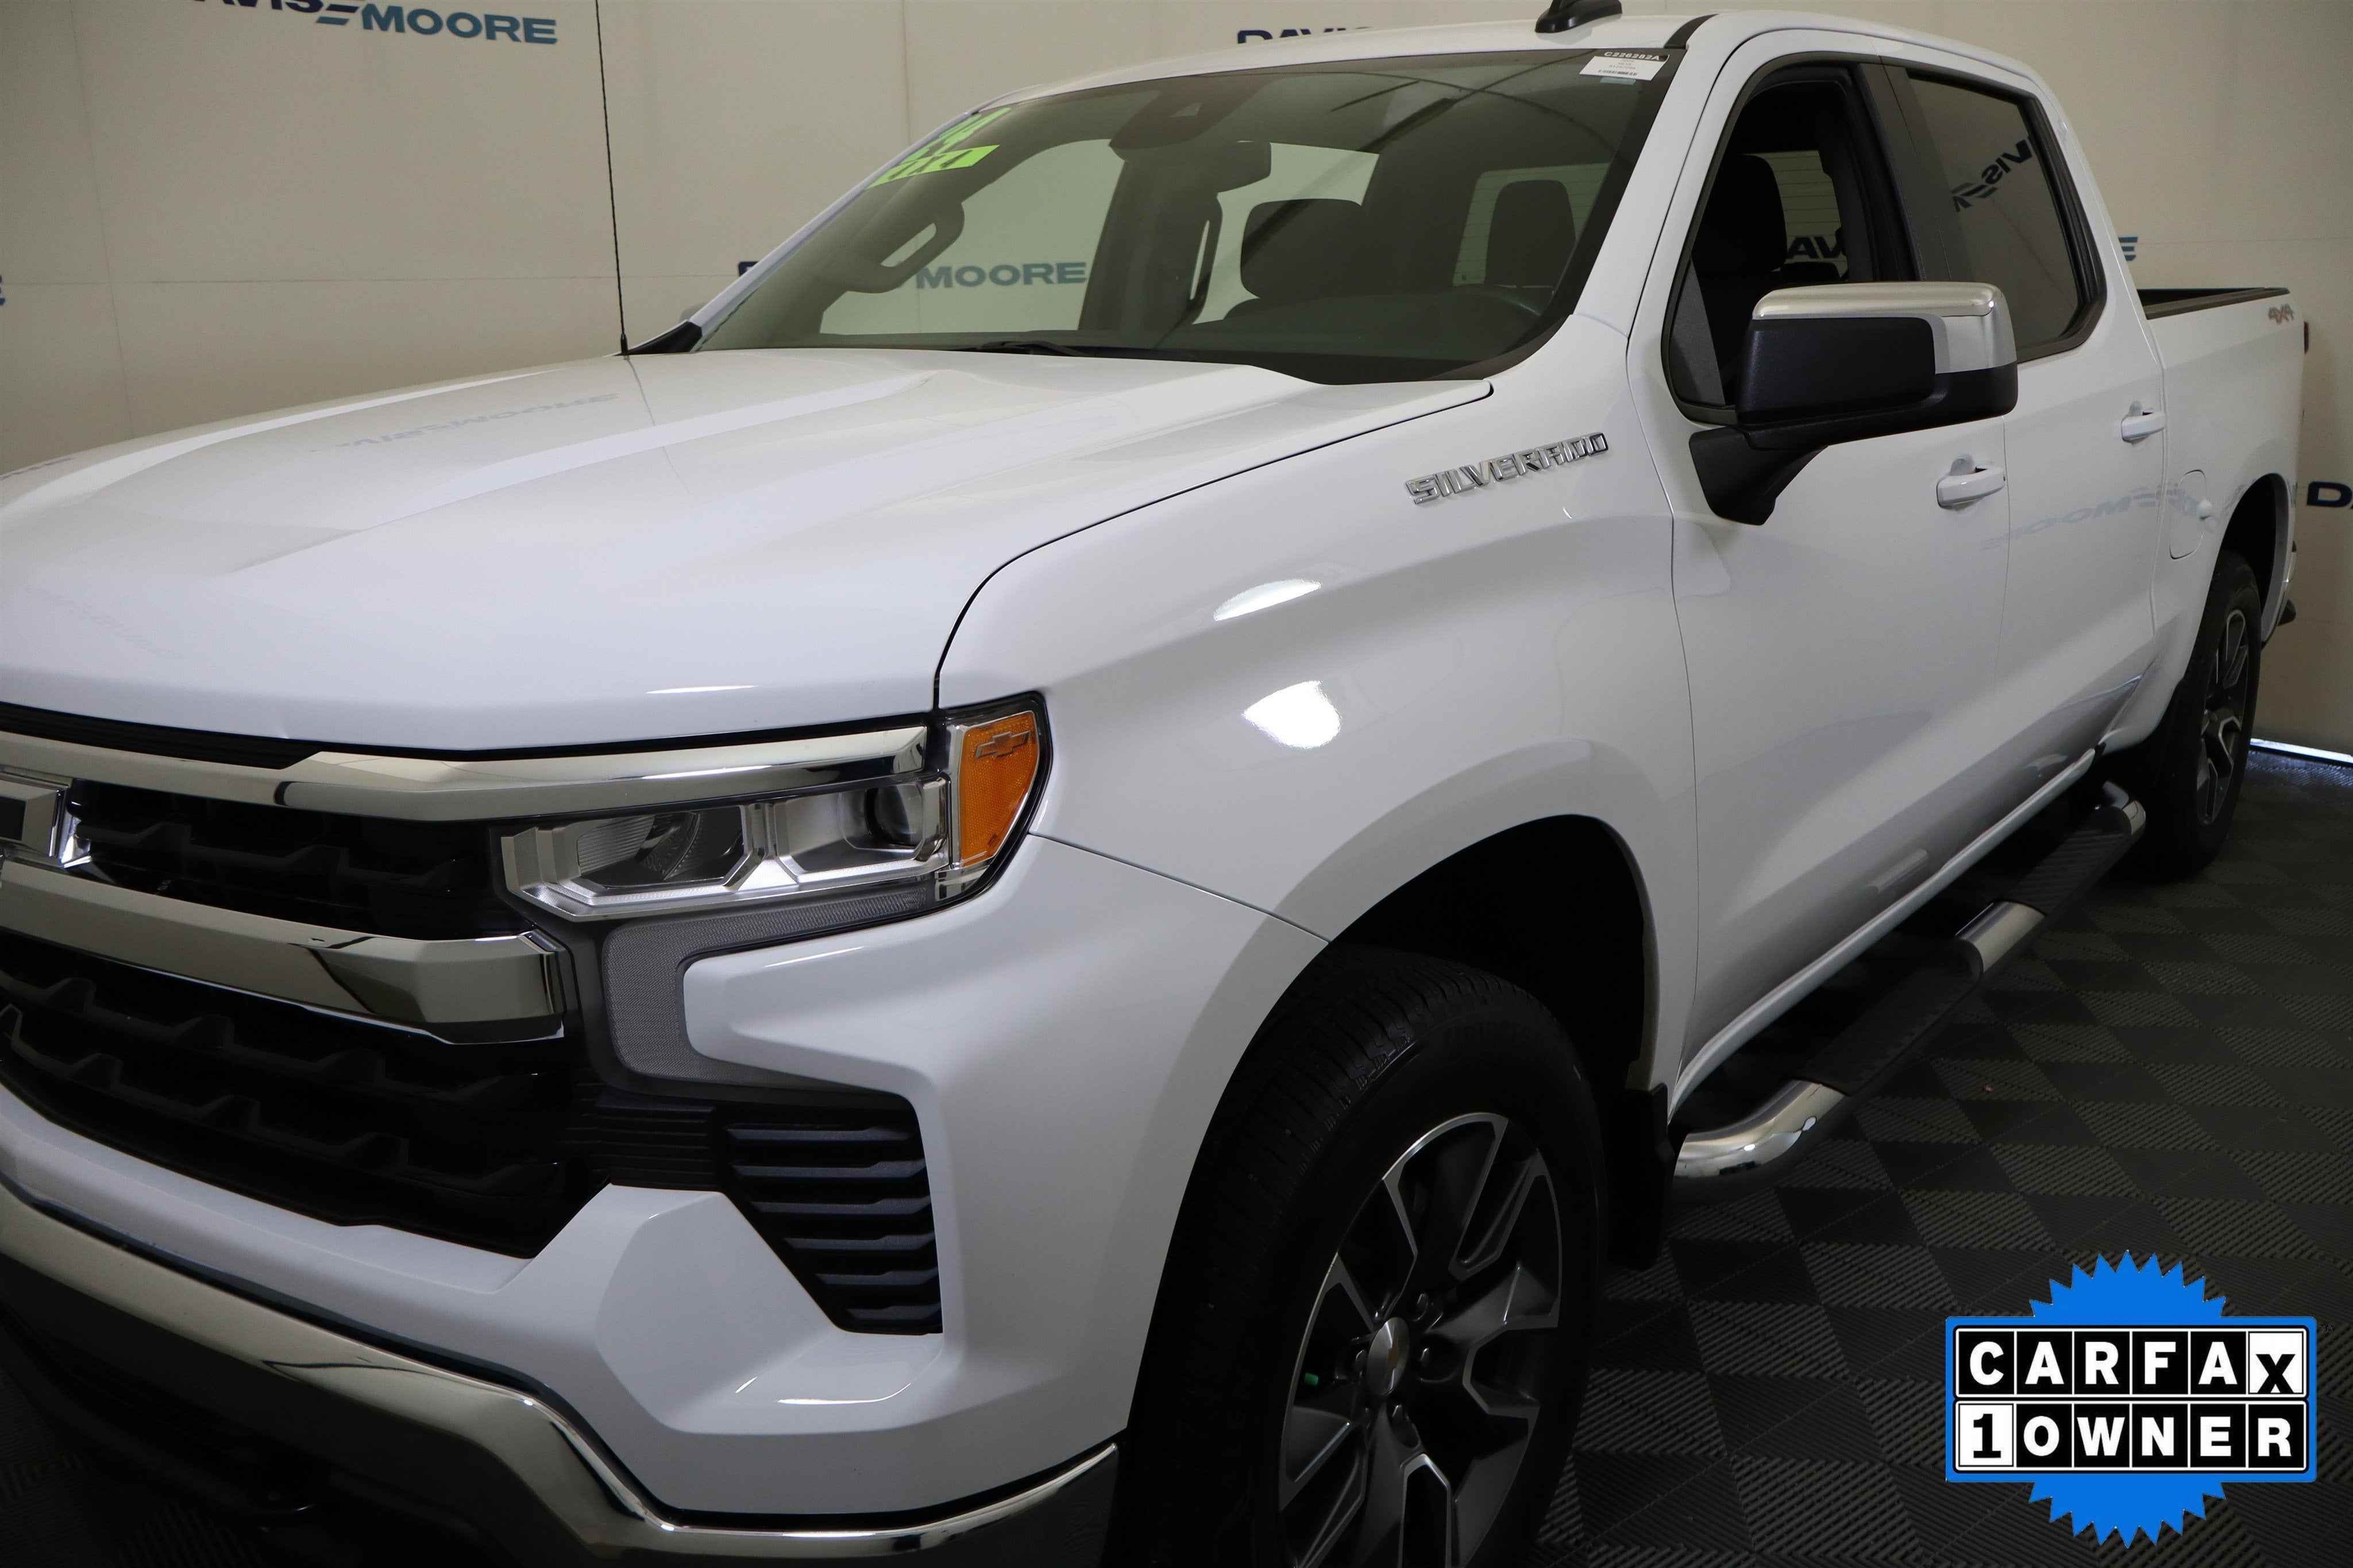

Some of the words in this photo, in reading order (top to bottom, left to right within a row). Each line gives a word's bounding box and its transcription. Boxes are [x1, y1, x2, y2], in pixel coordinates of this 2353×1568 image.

[361, 4, 558, 44] MOORE
[916, 261, 1087, 289] MOORE
[1405, 431, 1609, 505] SILVERADO
